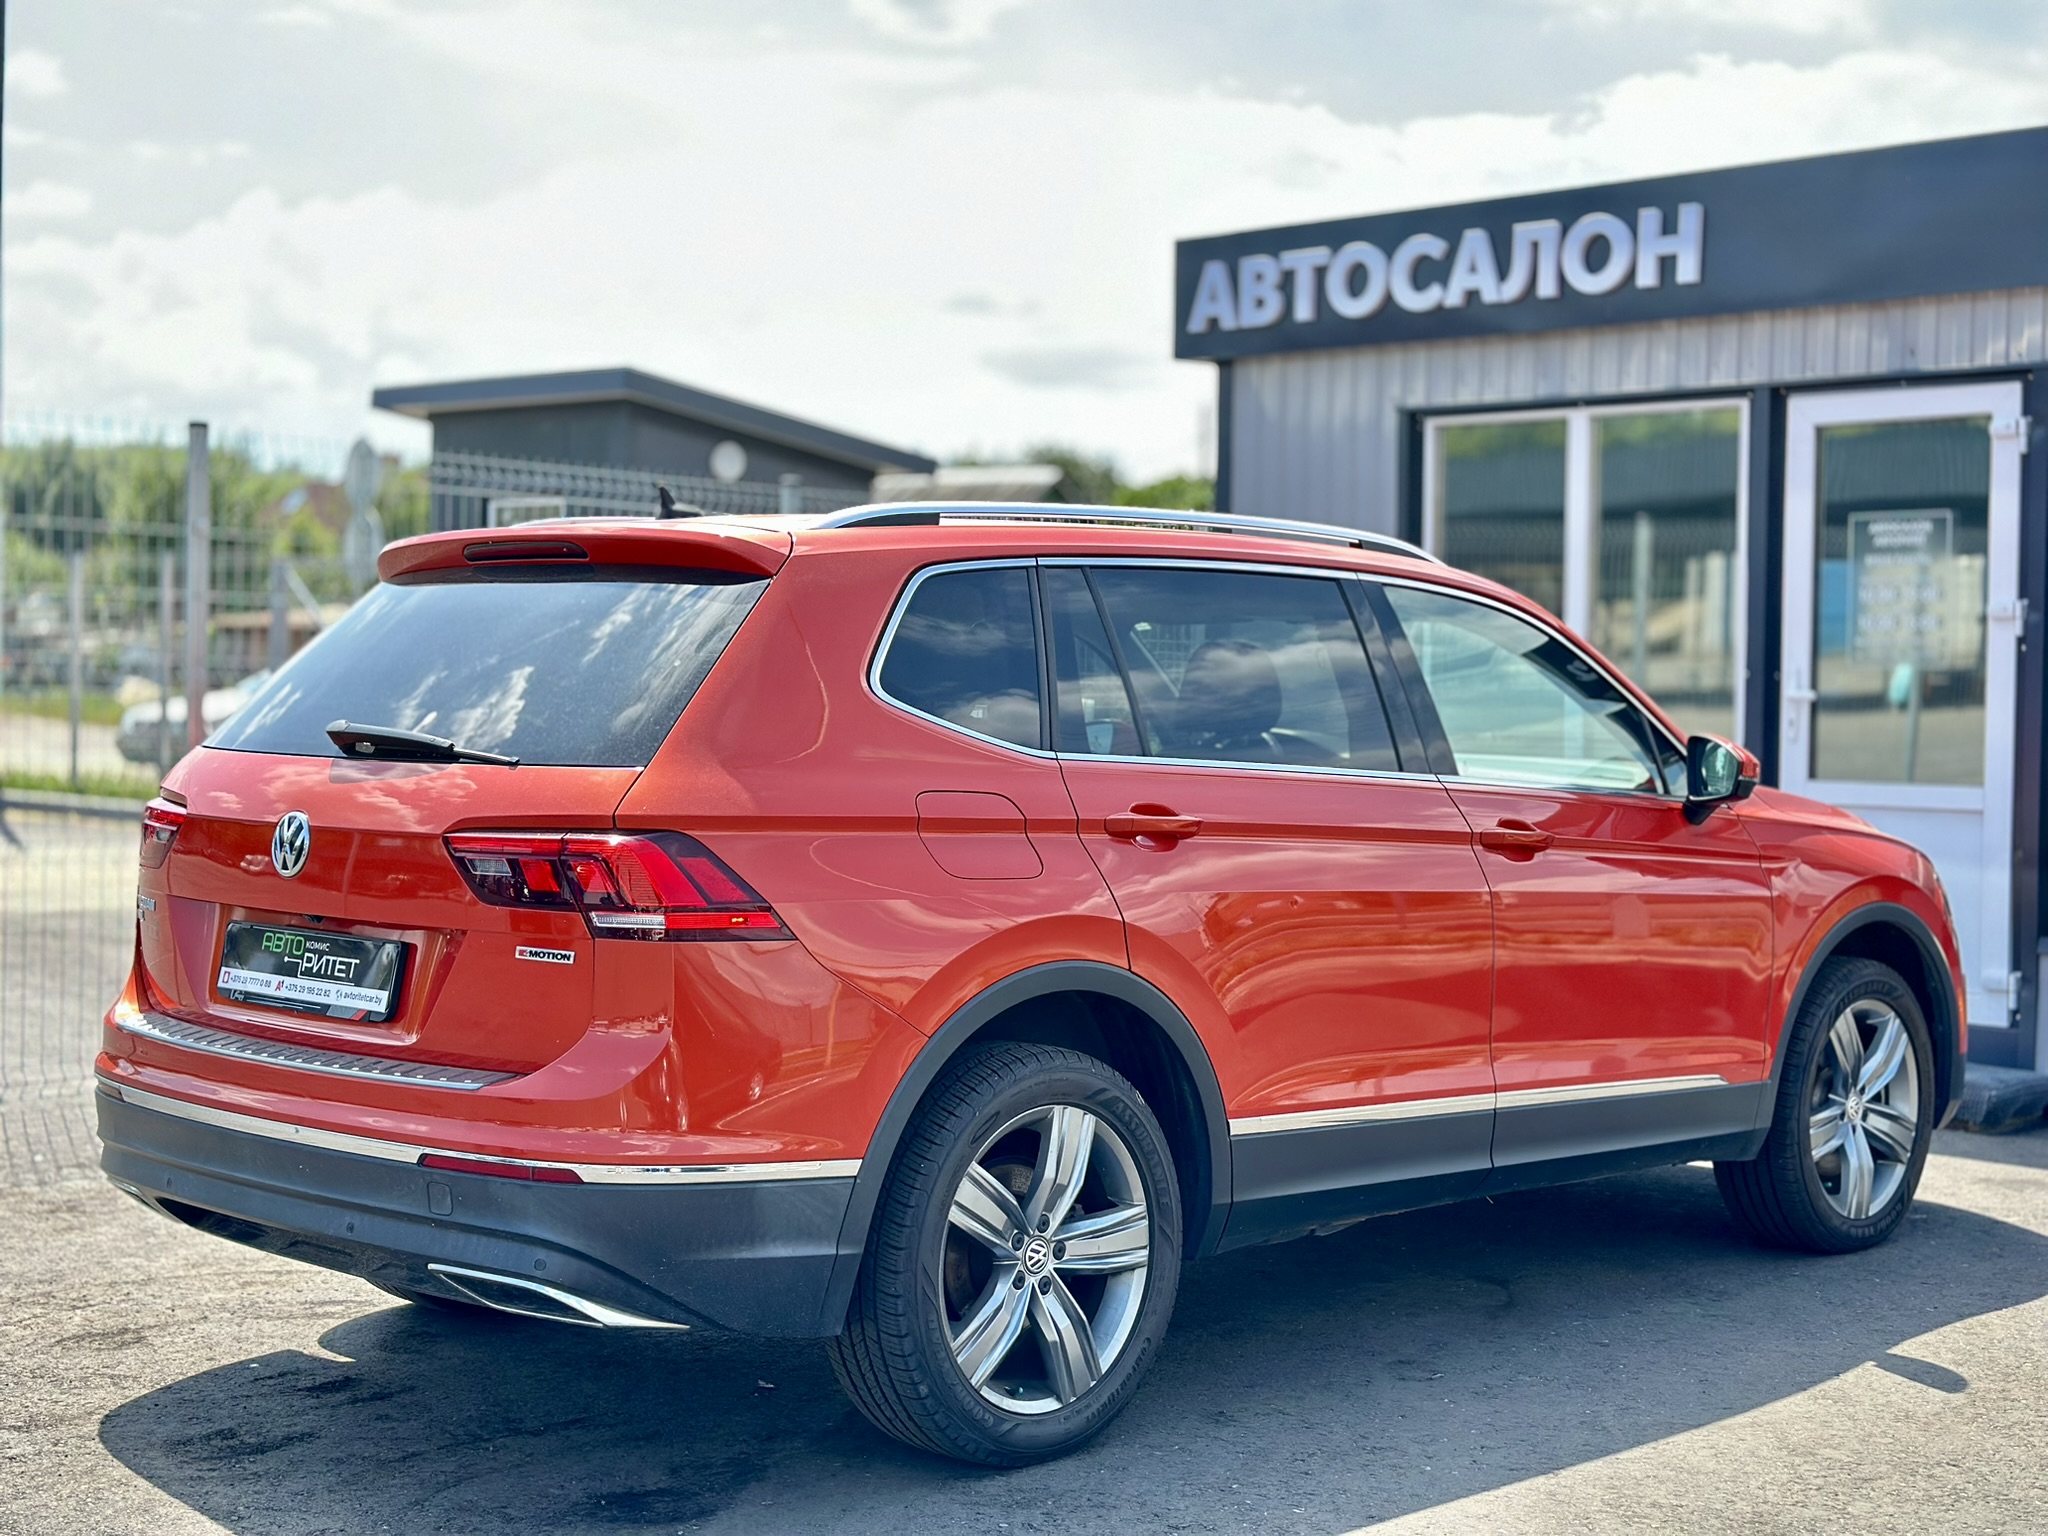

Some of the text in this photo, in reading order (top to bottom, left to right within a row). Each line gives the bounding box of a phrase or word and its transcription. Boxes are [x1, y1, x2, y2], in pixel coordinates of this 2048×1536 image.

[1186, 201, 1704, 333] АВТОСАЛОН
[262, 932, 305, 955] АВТО
[302, 952, 360, 978] РИТЕТ
